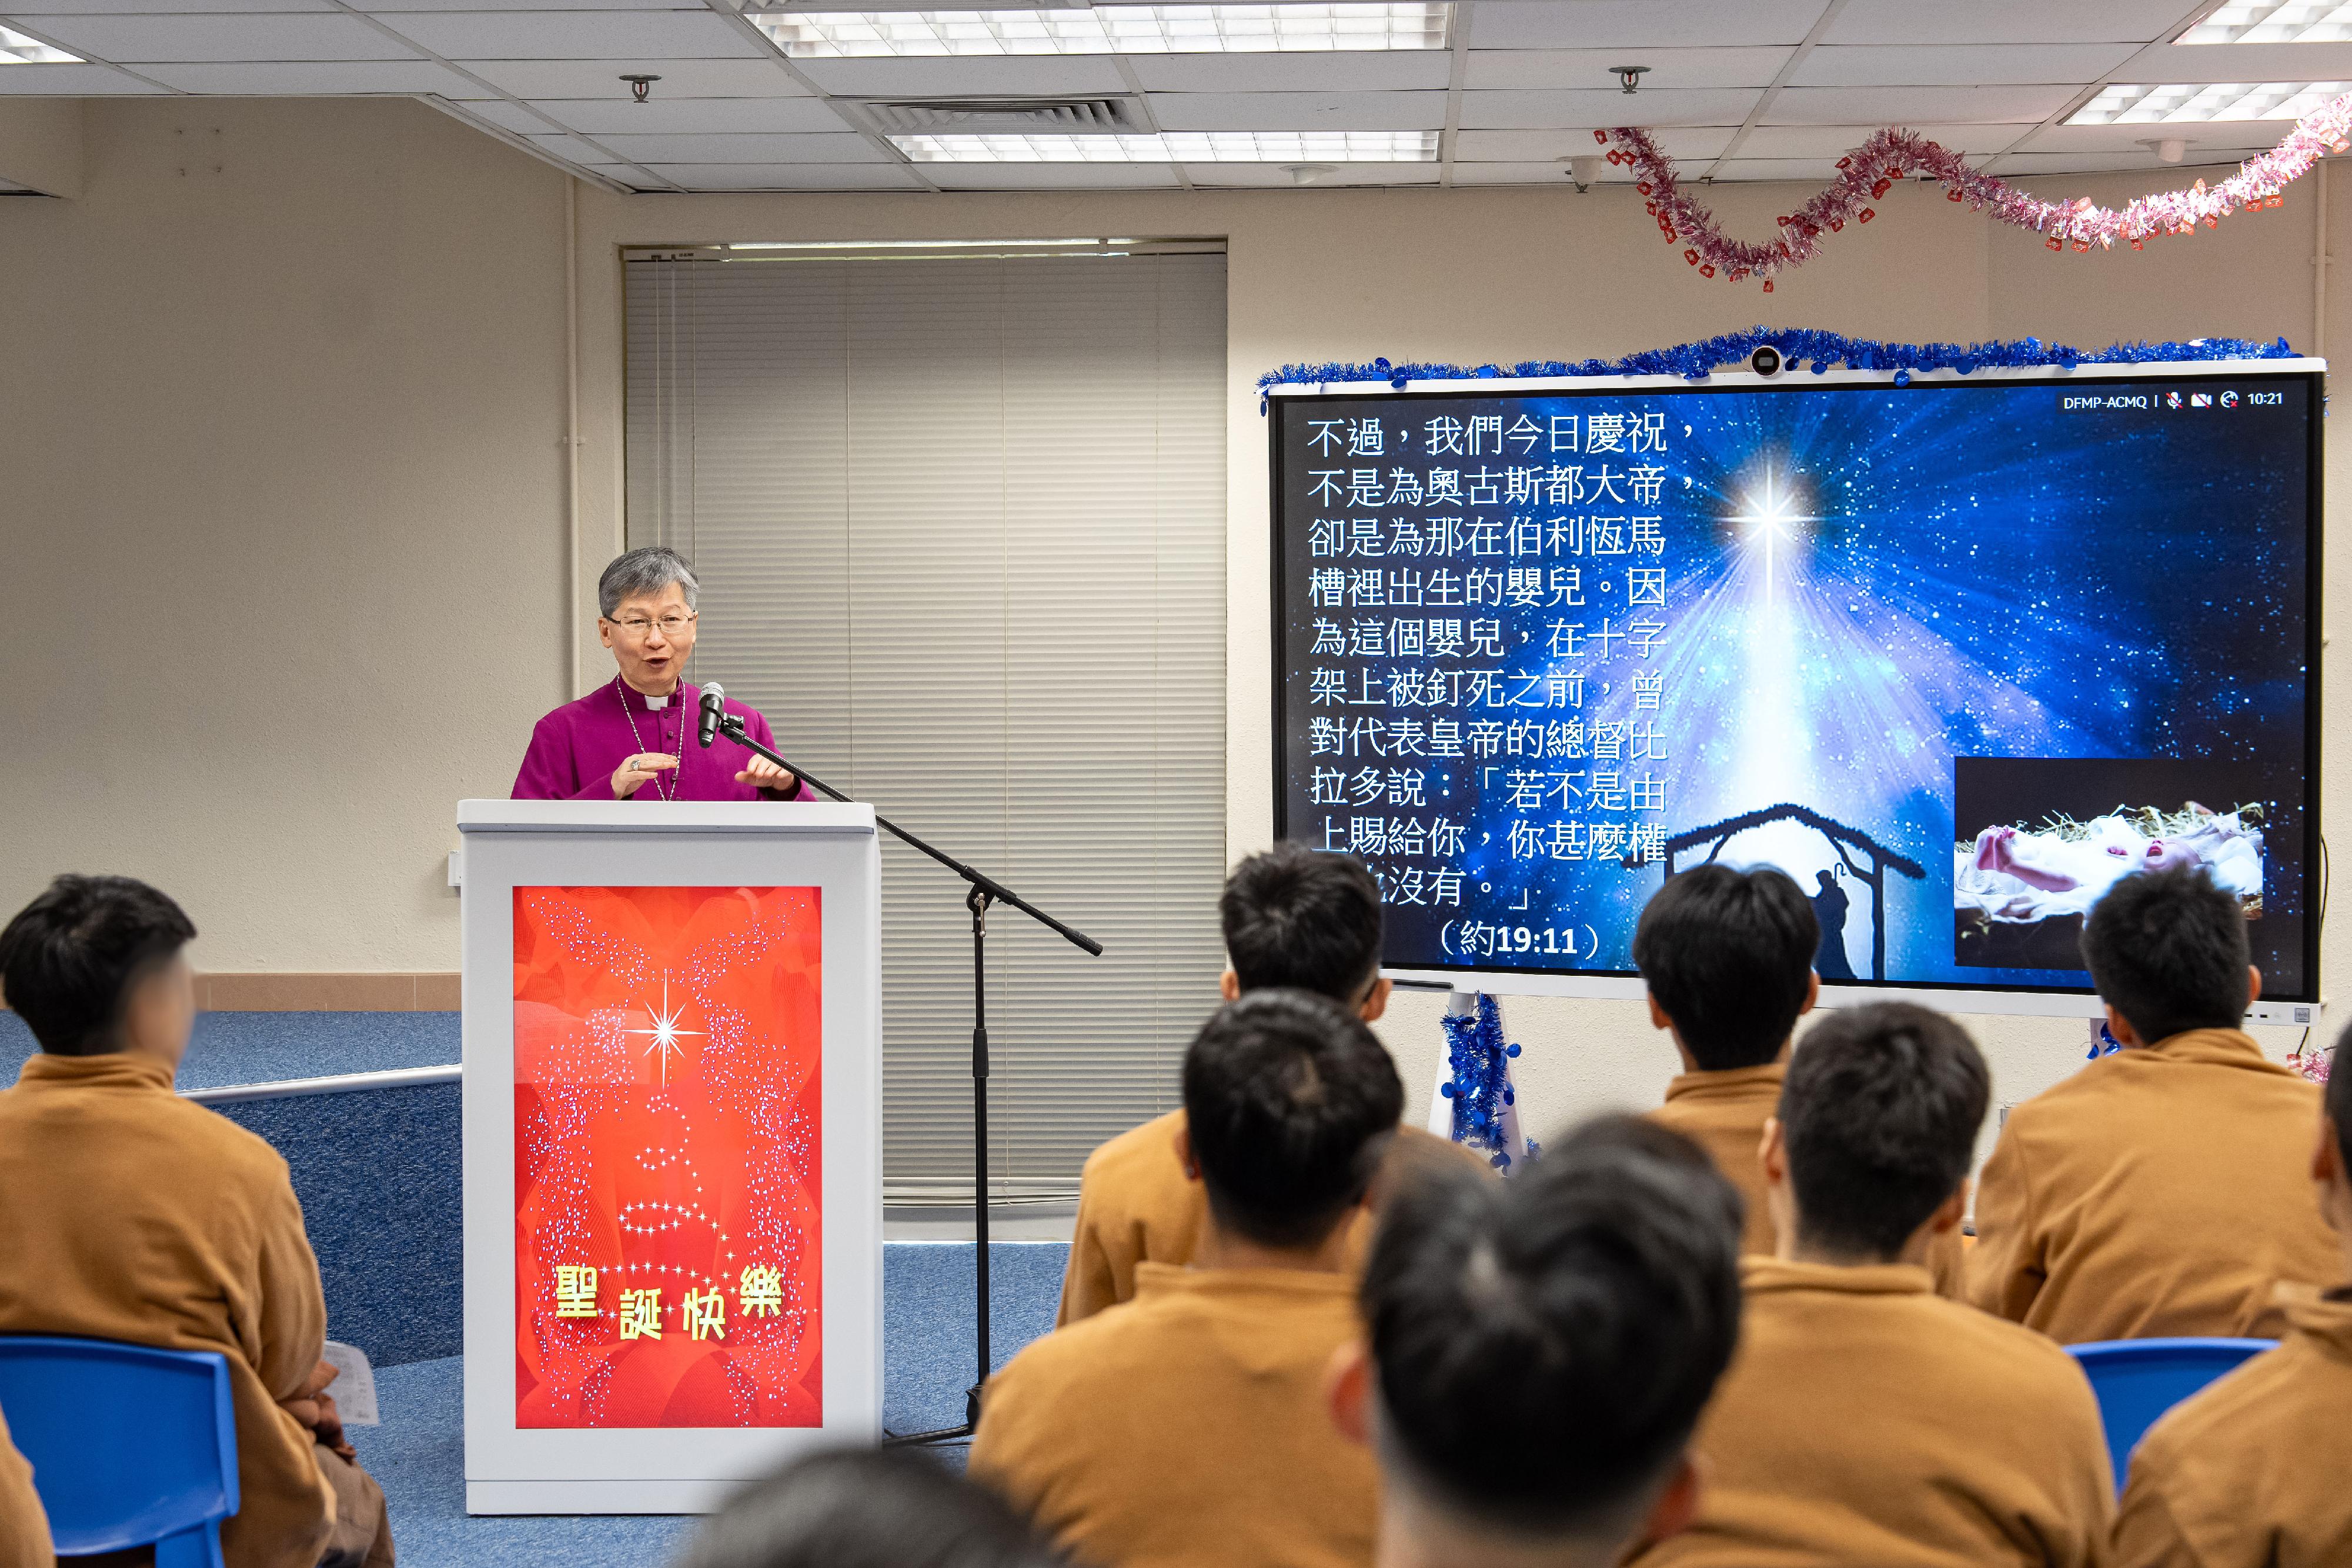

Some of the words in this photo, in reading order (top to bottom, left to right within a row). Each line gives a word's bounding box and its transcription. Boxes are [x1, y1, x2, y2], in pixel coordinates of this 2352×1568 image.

[2064, 396, 2147, 409] DFMP-ACMQ
[2248, 393, 2282, 404] 10:21
[1307, 412, 1692, 457] 不過，我們今日慶祝，
[1307, 515, 1666, 558] 卻是為那在伯利恆馬
[1308, 567, 1667, 607] 槽裡出生的嬰兒。因
[1310, 617, 1667, 658] 為這個嬰兒，在十字
[1309, 667, 1665, 710] 架上被釘死之前，曾
[1309, 716, 1668, 761] 對代表皇帝的總督比
[1310, 765, 1666, 812] 拉多說：「若不是由
[1311, 815, 1668, 862] 上賜給你，你甚麼權
[555, 1264, 783, 1341] 聖誕快樂
